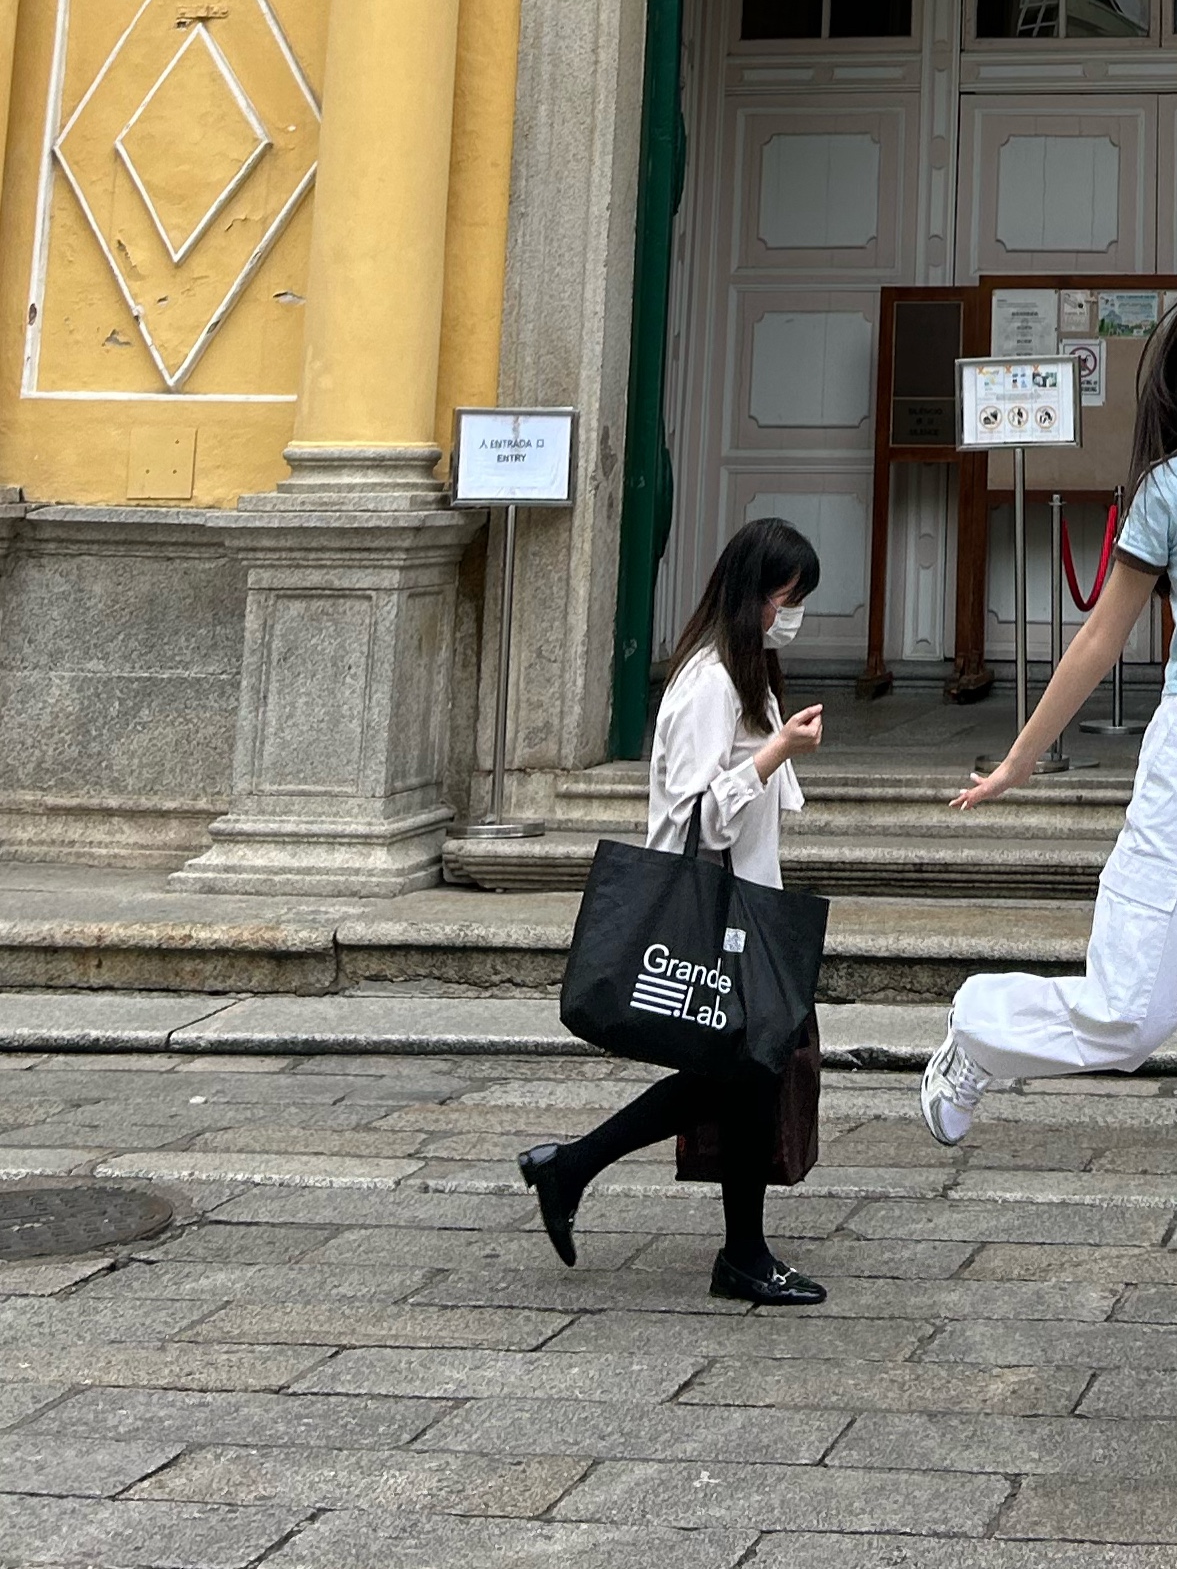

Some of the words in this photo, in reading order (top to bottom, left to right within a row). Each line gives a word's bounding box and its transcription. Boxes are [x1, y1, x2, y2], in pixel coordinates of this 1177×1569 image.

[490, 439, 532, 449] ENTRADA
[497, 453, 526, 463] ENTRY
[643, 943, 732, 994] Grande
